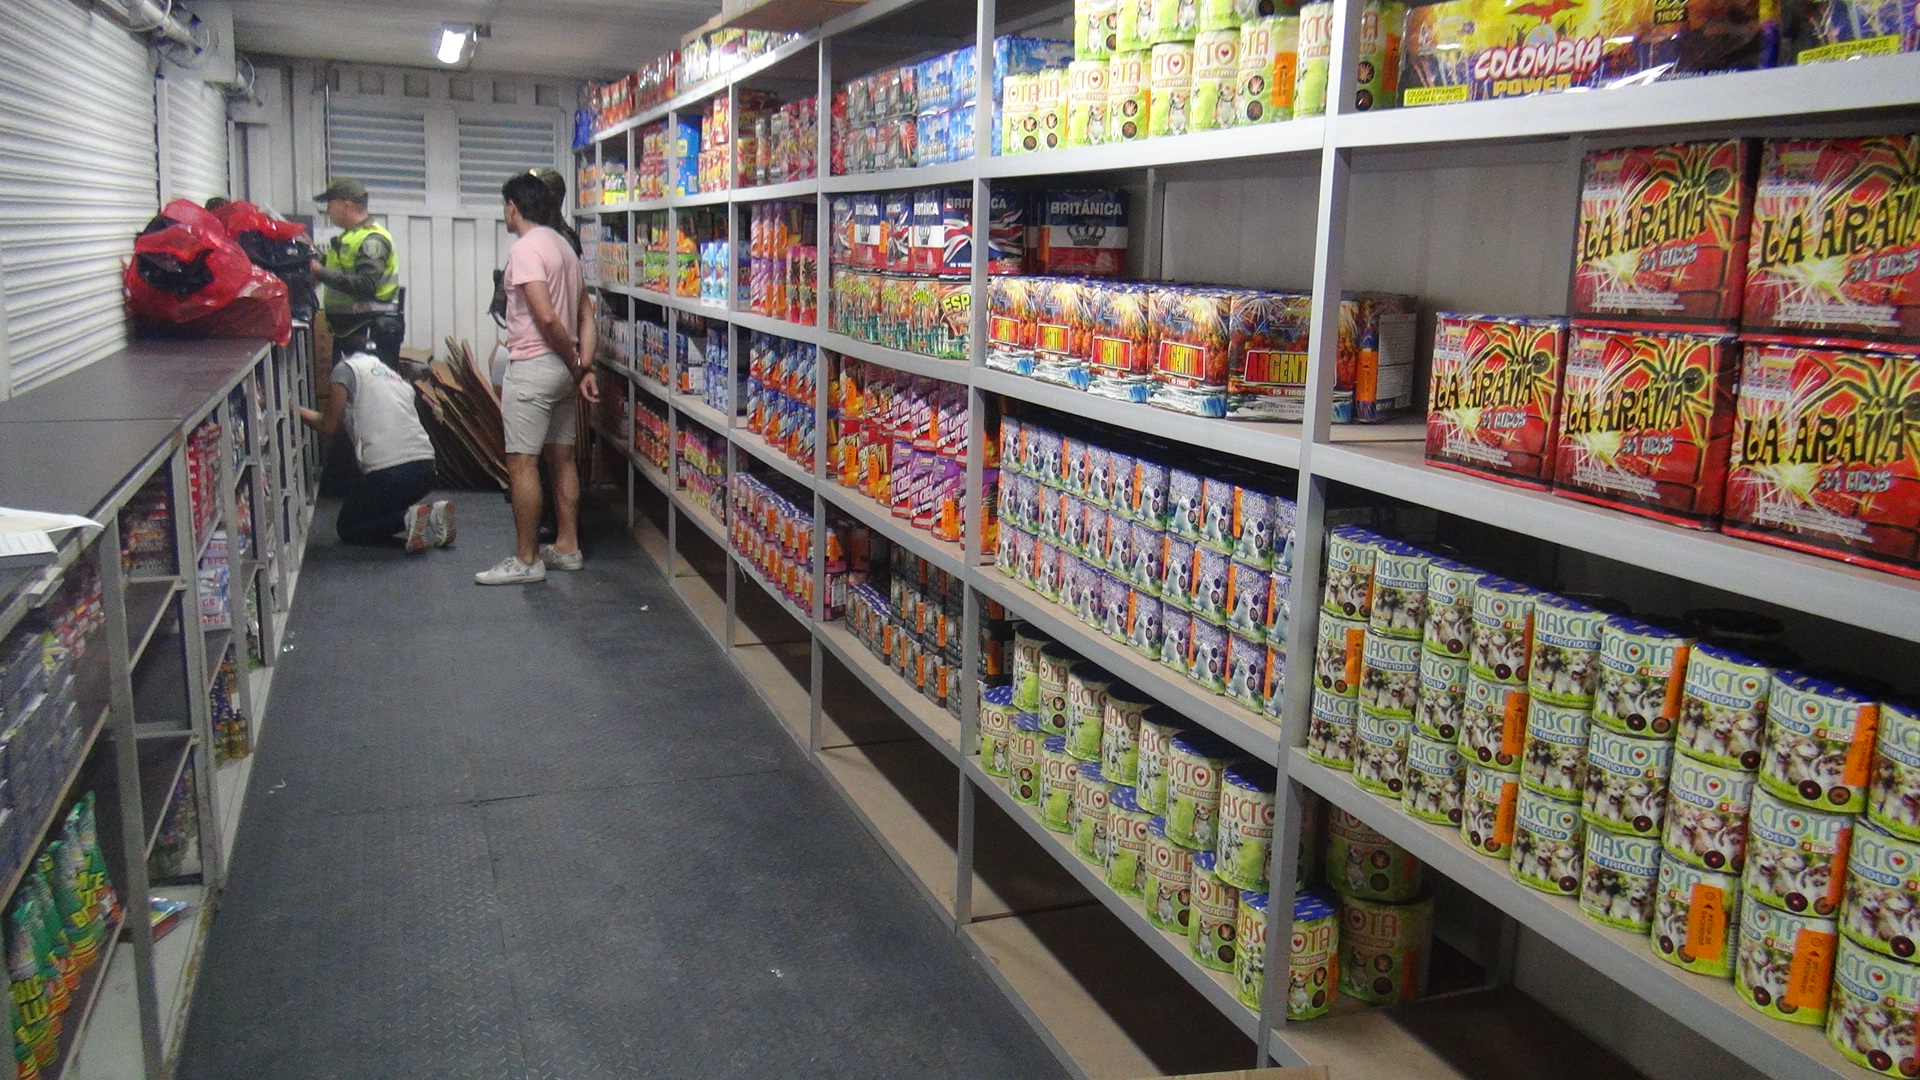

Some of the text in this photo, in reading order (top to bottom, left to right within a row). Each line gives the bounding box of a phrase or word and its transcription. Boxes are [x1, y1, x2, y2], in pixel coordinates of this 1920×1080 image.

[1475, 33, 1604, 81] COLOMBIA
[1493, 73, 1572, 97] POWER
[1050, 199, 1123, 216] BRITÁNICA
[1582, 214, 1614, 263] LA
[1759, 188, 1920, 269] LA ARAÑ
[1433, 373, 1461, 411] LA
[1564, 391, 1592, 435] LA
[1740, 417, 1780, 465] LA
[1550, 636, 1597, 650] FRIENDLY
[1693, 687, 1745, 709] FRIENDLY
[1538, 729, 1587, 746] FRIENDLY
[1412, 759, 1451, 775] FRIENDLY
[1591, 754, 1637, 776] FRIENDLY
[1519, 819, 1562, 840] FRIENDLY
